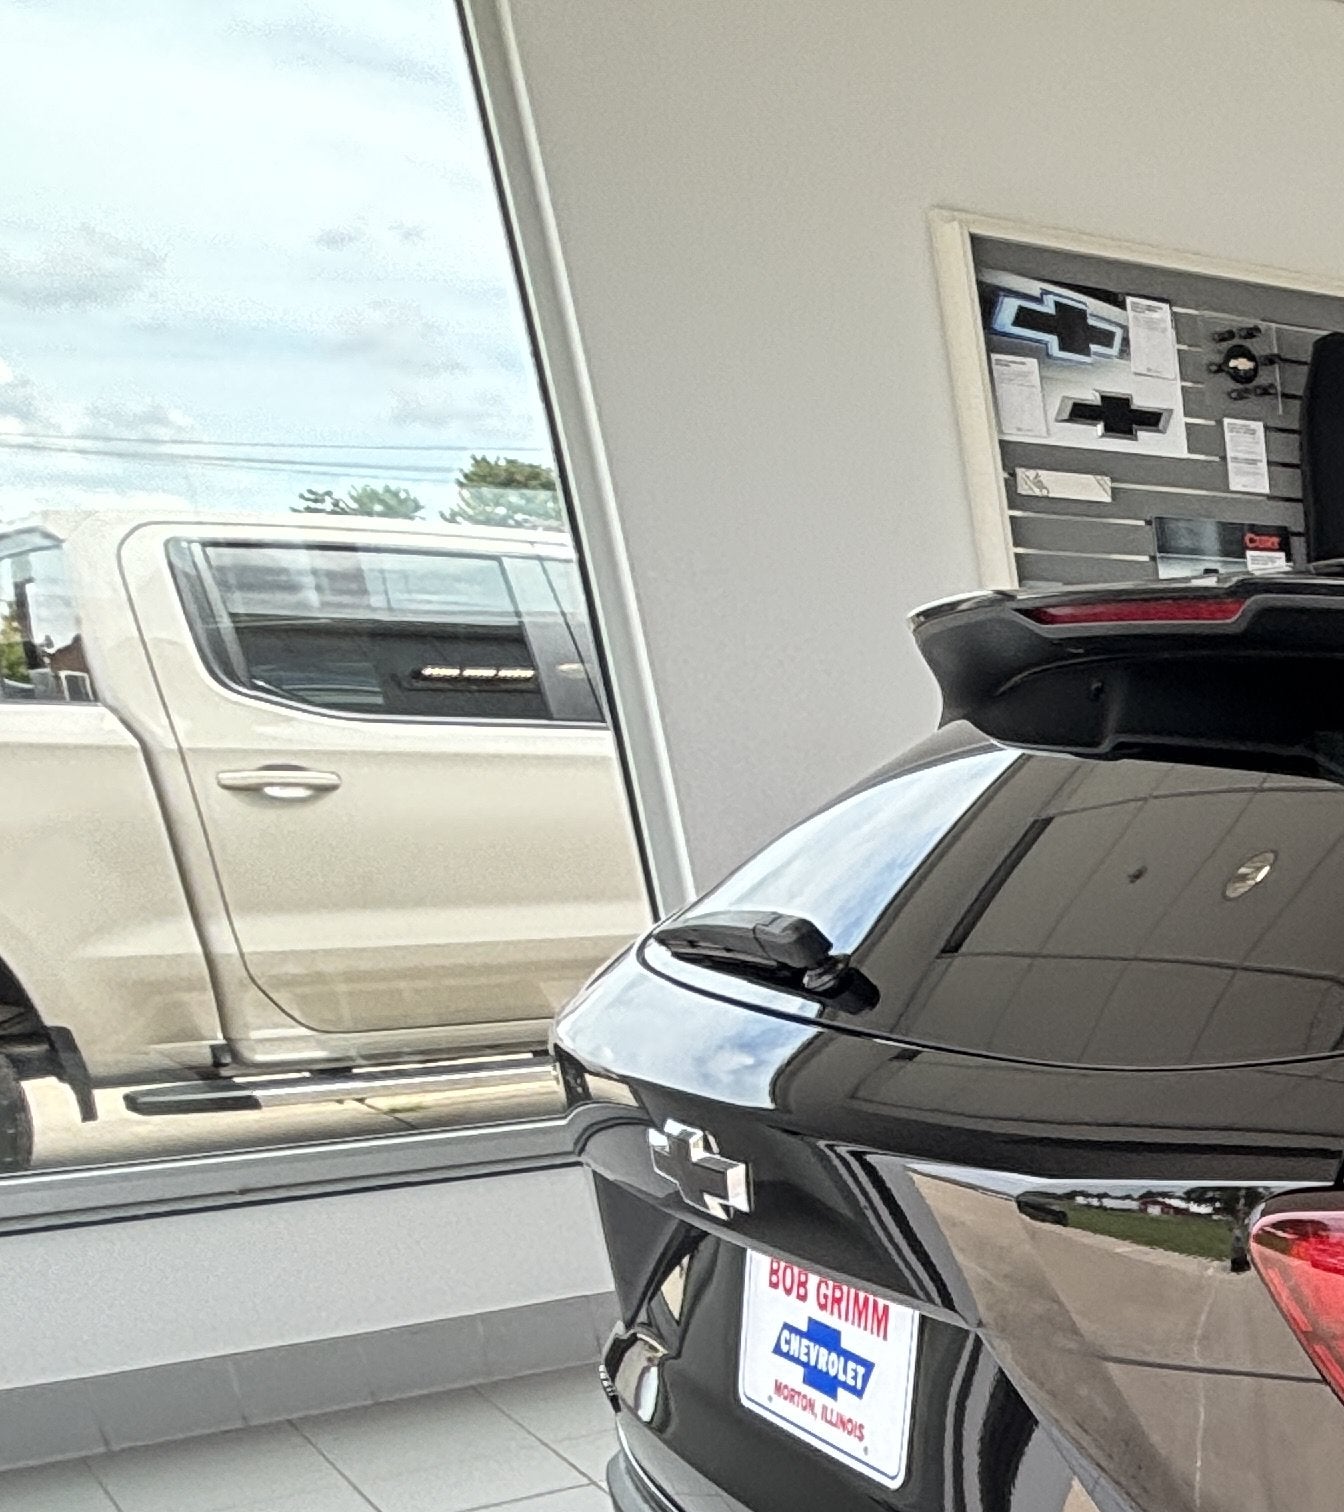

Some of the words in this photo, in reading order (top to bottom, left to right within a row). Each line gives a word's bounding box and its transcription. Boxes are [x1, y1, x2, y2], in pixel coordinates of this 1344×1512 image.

[768, 1257, 809, 1303] BOB
[816, 1277, 890, 1342] GRIMM
[779, 1328, 866, 1391] CHEVROLET
[773, 1378, 818, 1422] MORTON,
[820, 1403, 866, 1442] ILLINOIS
